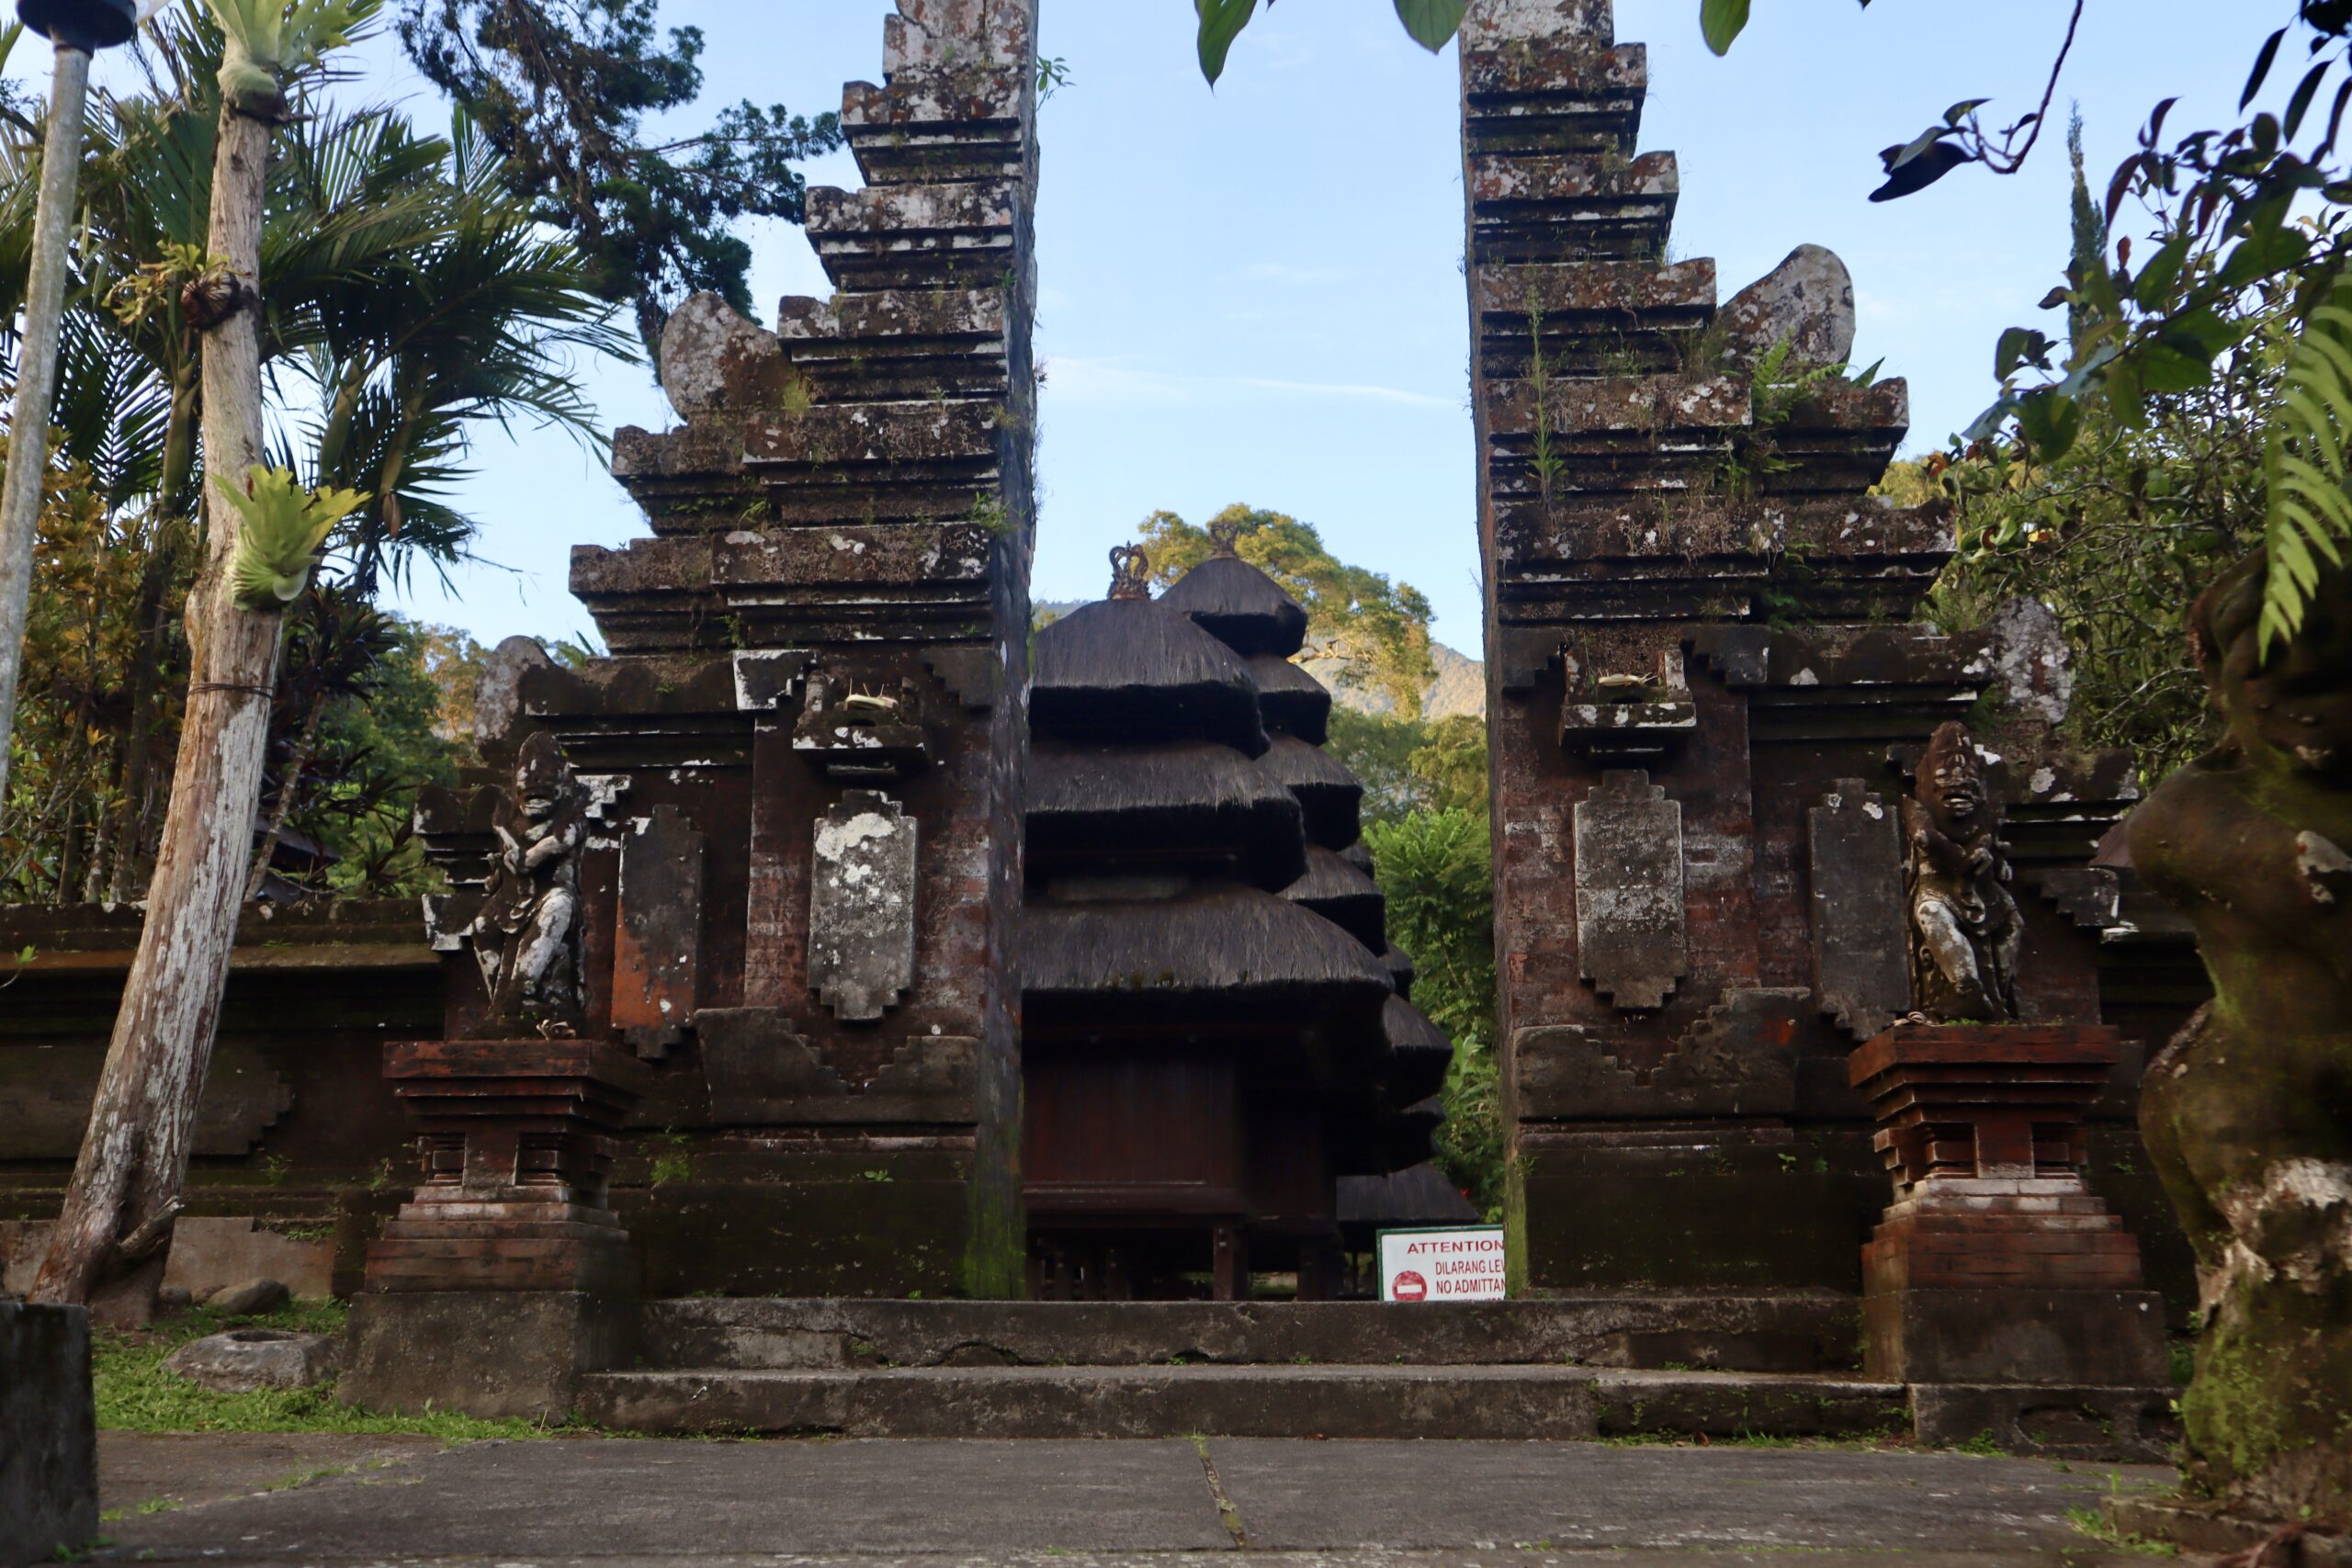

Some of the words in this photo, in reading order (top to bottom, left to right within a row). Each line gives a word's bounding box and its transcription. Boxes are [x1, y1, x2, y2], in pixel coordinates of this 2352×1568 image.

[1408, 1240, 1505, 1255] ATTENTION
[1435, 1259, 1486, 1275] DILARANG
[1436, 1280, 1452, 1294] NO
